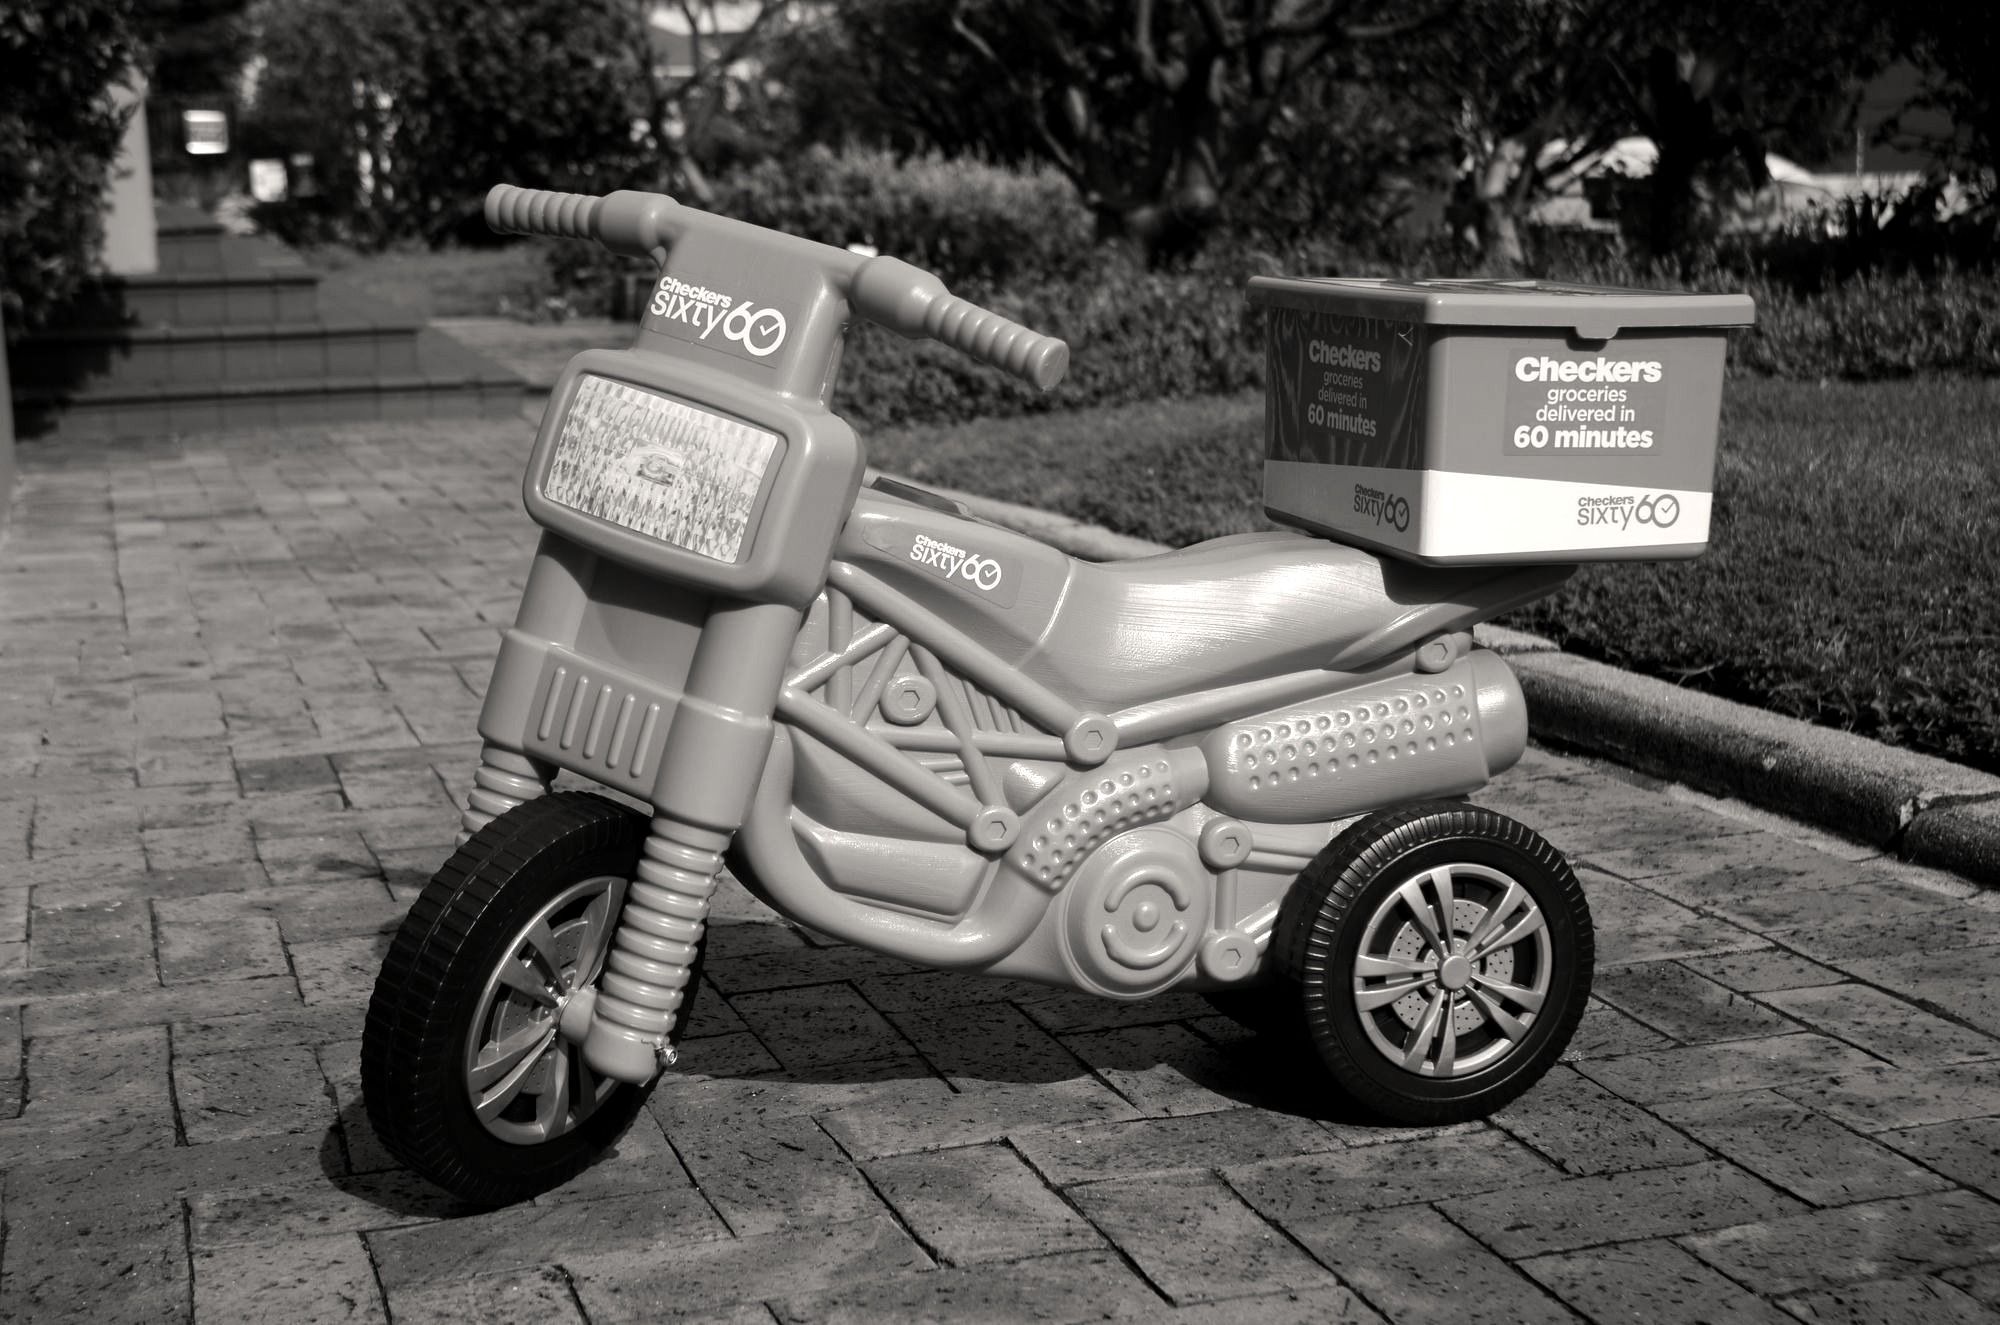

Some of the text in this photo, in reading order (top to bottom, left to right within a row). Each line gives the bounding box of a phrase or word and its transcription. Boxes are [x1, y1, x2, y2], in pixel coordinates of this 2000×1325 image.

[660, 276, 732, 308] Checkers
[1309, 339, 1381, 373] Checkers
[1323, 370, 1363, 389] groceries
[1515, 356, 1662, 382] Checkers
[1318, 388, 1367, 410] delivered in
[1547, 386, 1627, 404] groceries
[1308, 403, 1377, 437] 60 minutes
[1536, 405, 1635, 422] delivered in
[1514, 425, 1653, 448] 60 minutes
[1578, 495, 1635, 507] Checkers
[915, 534, 966, 558] Checkers
